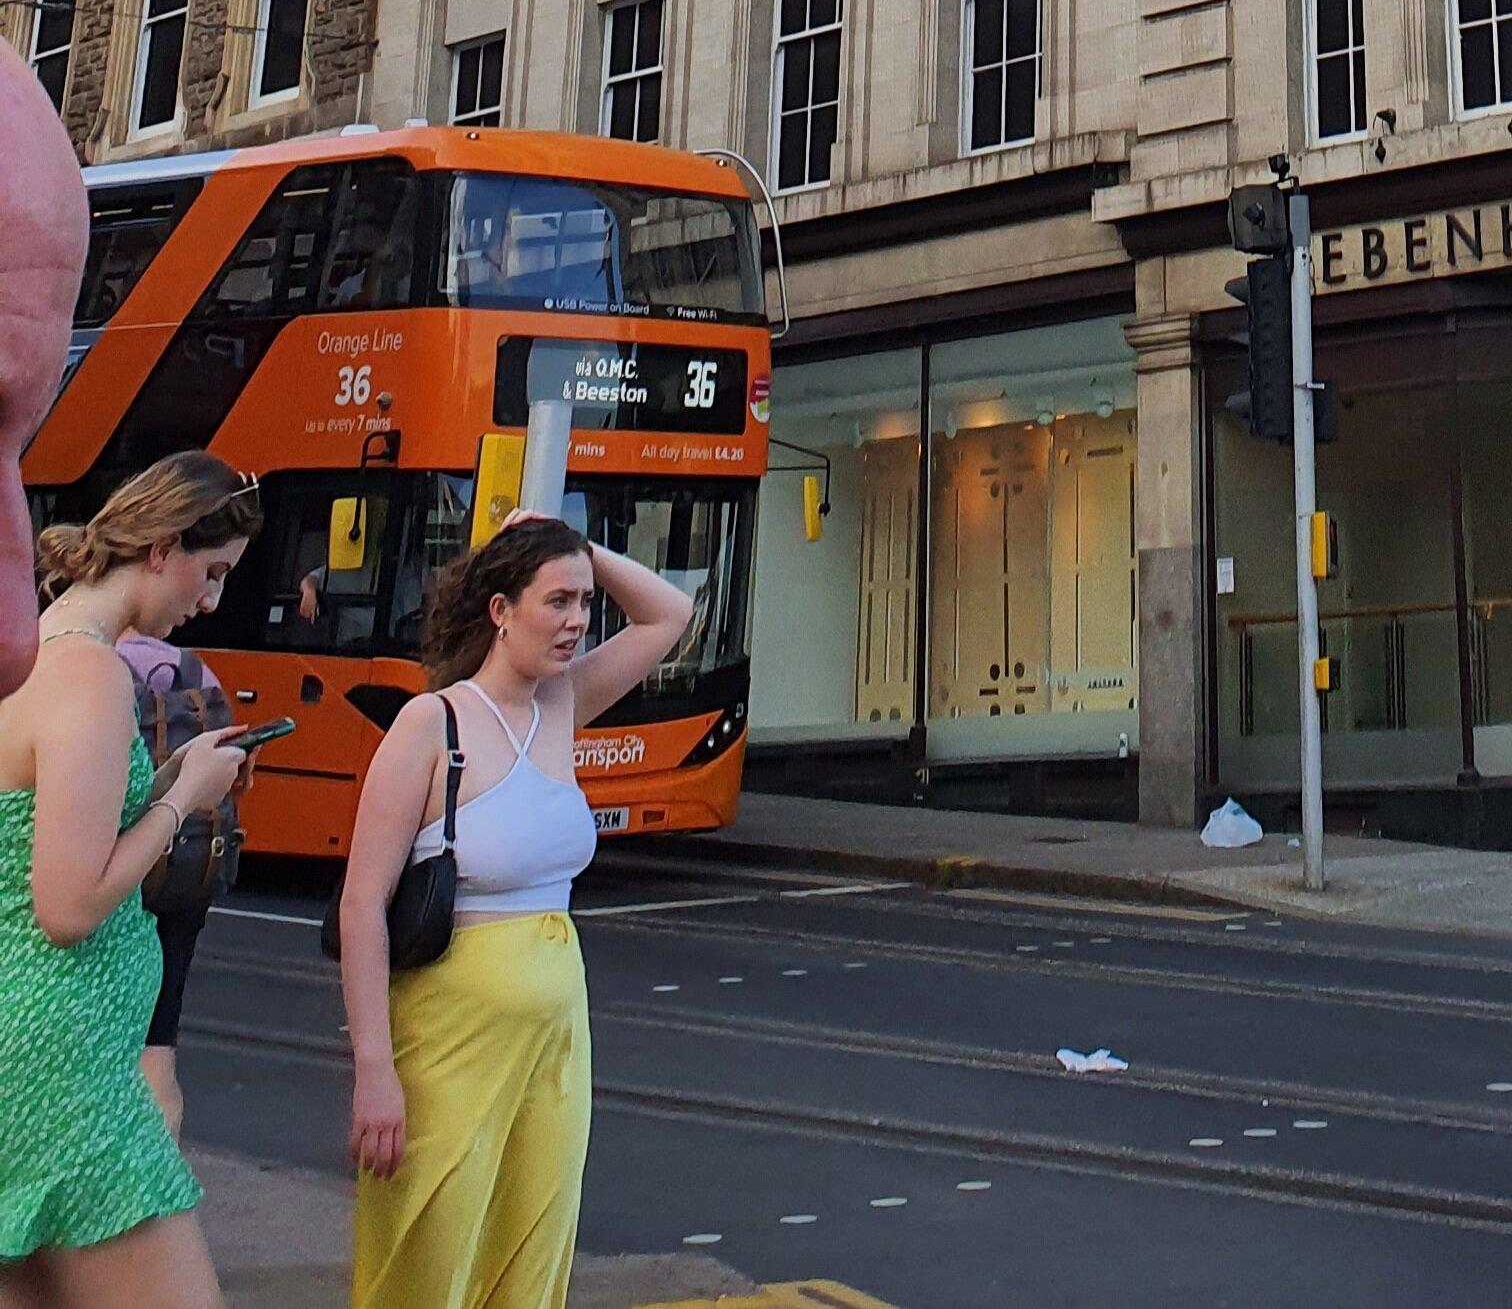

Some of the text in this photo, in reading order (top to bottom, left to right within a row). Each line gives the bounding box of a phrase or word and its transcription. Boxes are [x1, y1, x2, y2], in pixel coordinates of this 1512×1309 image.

[555, 297, 650, 316] USB Power on Board
[677, 306, 718, 321] Free Wi-Fi
[317, 327, 403, 359] Orange Line
[575, 356, 639, 379] via Q.M.C.
[334, 365, 372, 406] 36
[562, 380, 648, 404] & Beeston
[683, 360, 718, 408] 36
[327, 416, 356, 436] every
[357, 413, 366, 432] 7
[366, 412, 392, 431] mins
[574, 441, 606, 457] mins
[641, 442, 745, 462] All day travel £4.20
[573, 734, 643, 751] ottingham City
[573, 739, 645, 772] ansport
